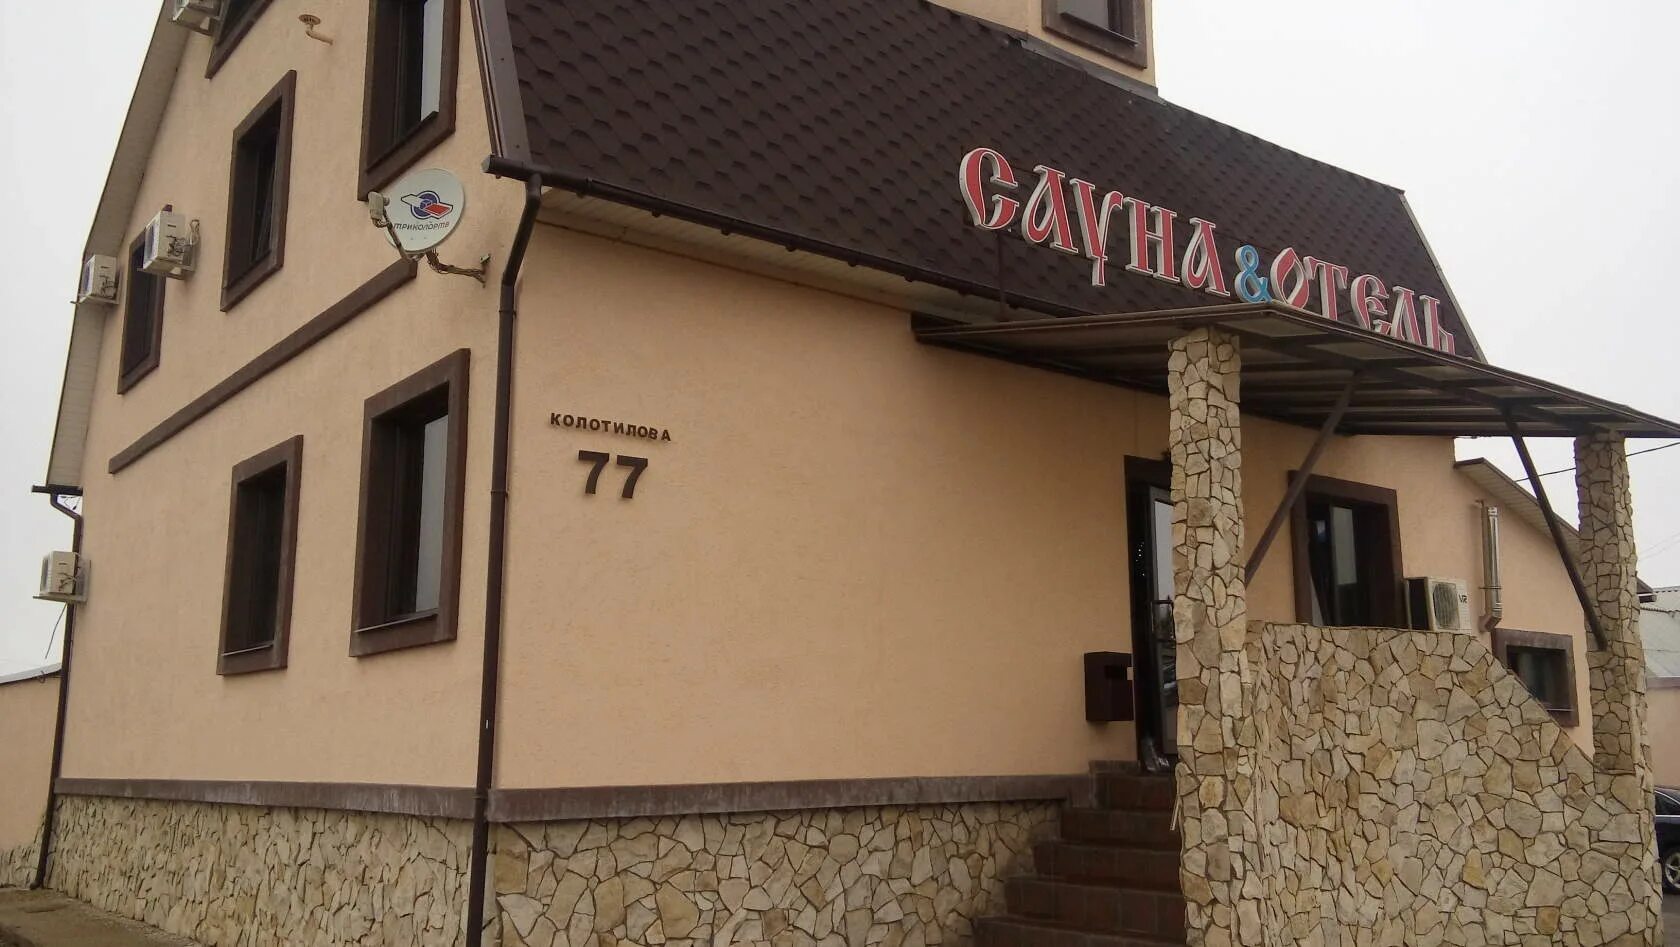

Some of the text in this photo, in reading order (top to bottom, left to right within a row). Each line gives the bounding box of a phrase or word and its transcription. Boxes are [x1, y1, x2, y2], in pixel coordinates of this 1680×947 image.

[959, 147, 1456, 355] САУНА & ОТЕЛЬ
[550, 412, 672, 441] КОЛОТИЛОВА
[577, 450, 649, 499] 77
